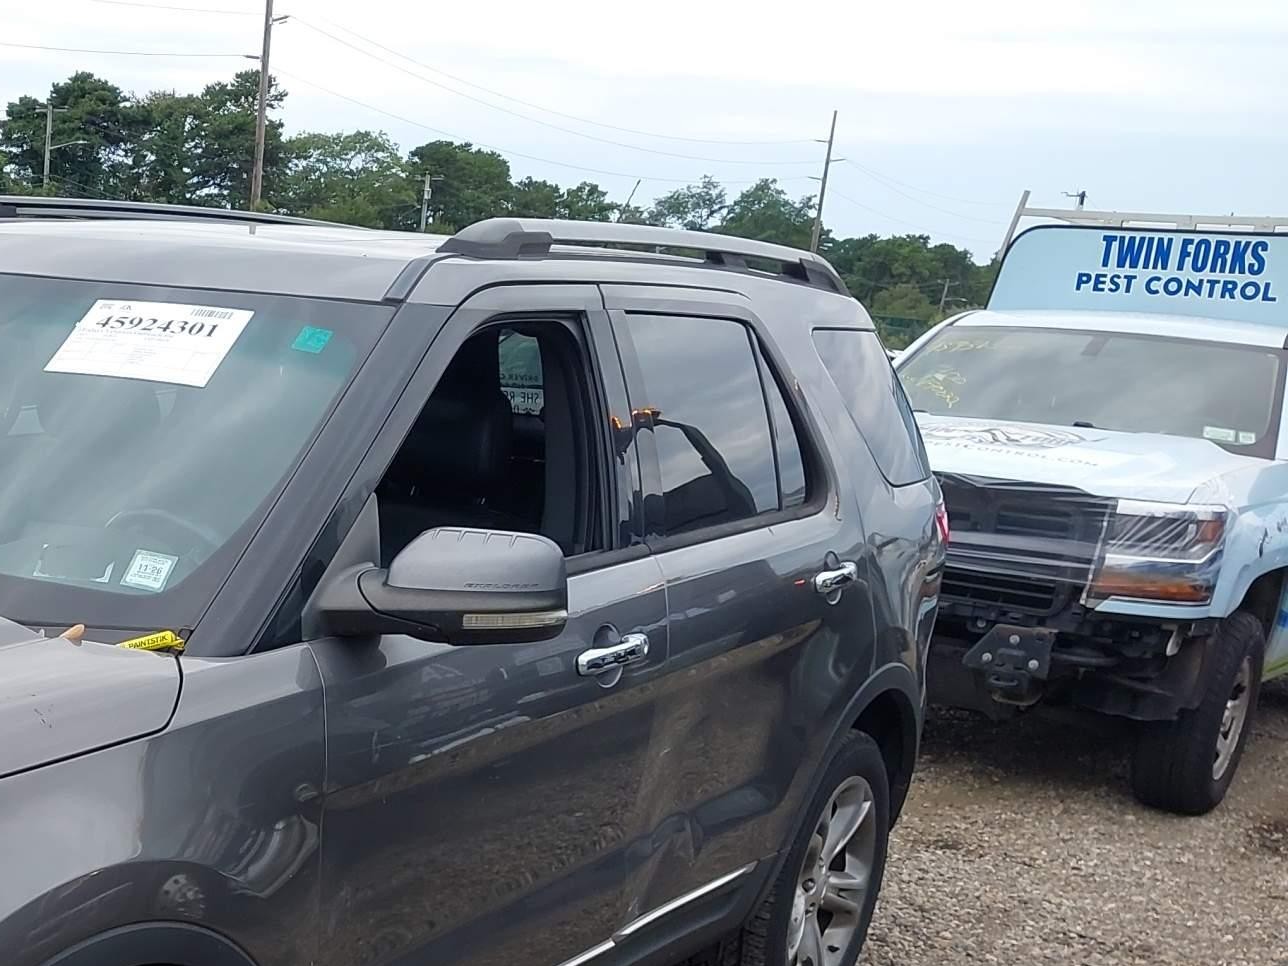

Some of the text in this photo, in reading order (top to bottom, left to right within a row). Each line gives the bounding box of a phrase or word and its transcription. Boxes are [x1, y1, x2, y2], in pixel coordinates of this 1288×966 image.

[1101, 234, 1269, 276] TWIN FORKS
[1075, 272, 1278, 303] PEST CONTROL
[95, 315, 219, 337] 45924301
